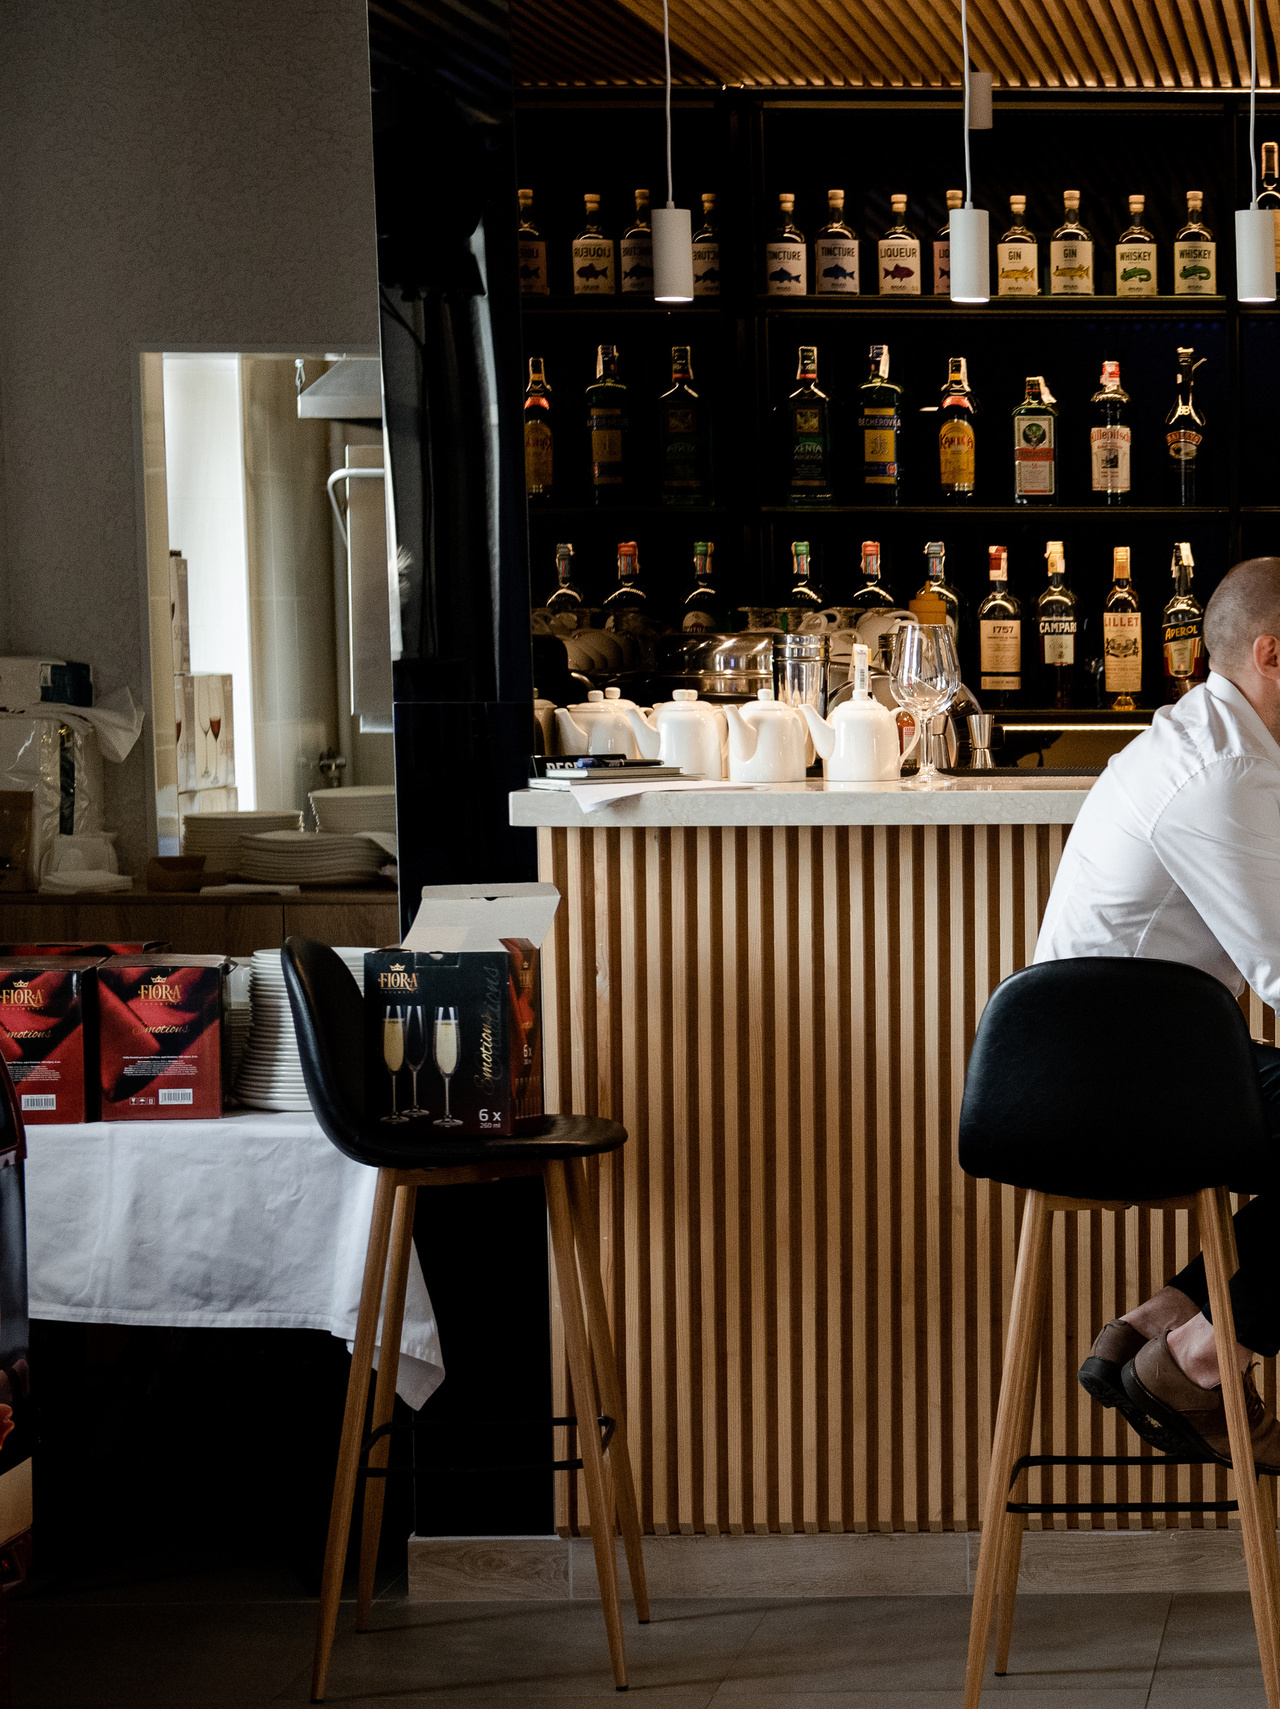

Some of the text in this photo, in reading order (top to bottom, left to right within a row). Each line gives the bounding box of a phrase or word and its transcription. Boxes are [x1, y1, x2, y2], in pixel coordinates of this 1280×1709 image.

[768, 250, 802, 261] TINCTURE
[821, 246, 855, 258] TINCTURE
[880, 247, 917, 259] LIQUEUR
[1008, 251, 1022, 261] GIN
[1063, 248, 1077, 259] GIN
[1119, 251, 1152, 261] WHISKEY
[1179, 249, 1211, 259] WHISKEY
[858, 417, 901, 427] BECHEROVKA
[1039, 621, 1077, 634] CAMPARI
[1104, 617, 1139, 627] LILLET
[992, 625, 1014, 634] 1757
[1165, 625, 1198, 642] APEROL
[378, 972, 418, 992] FIORA
[0, 988, 44, 1008] FIORA
[138, 984, 181, 1003] FIORA
[473, 1013, 495, 1096] Emotions
[478, 1108, 502, 1122] 6 x
